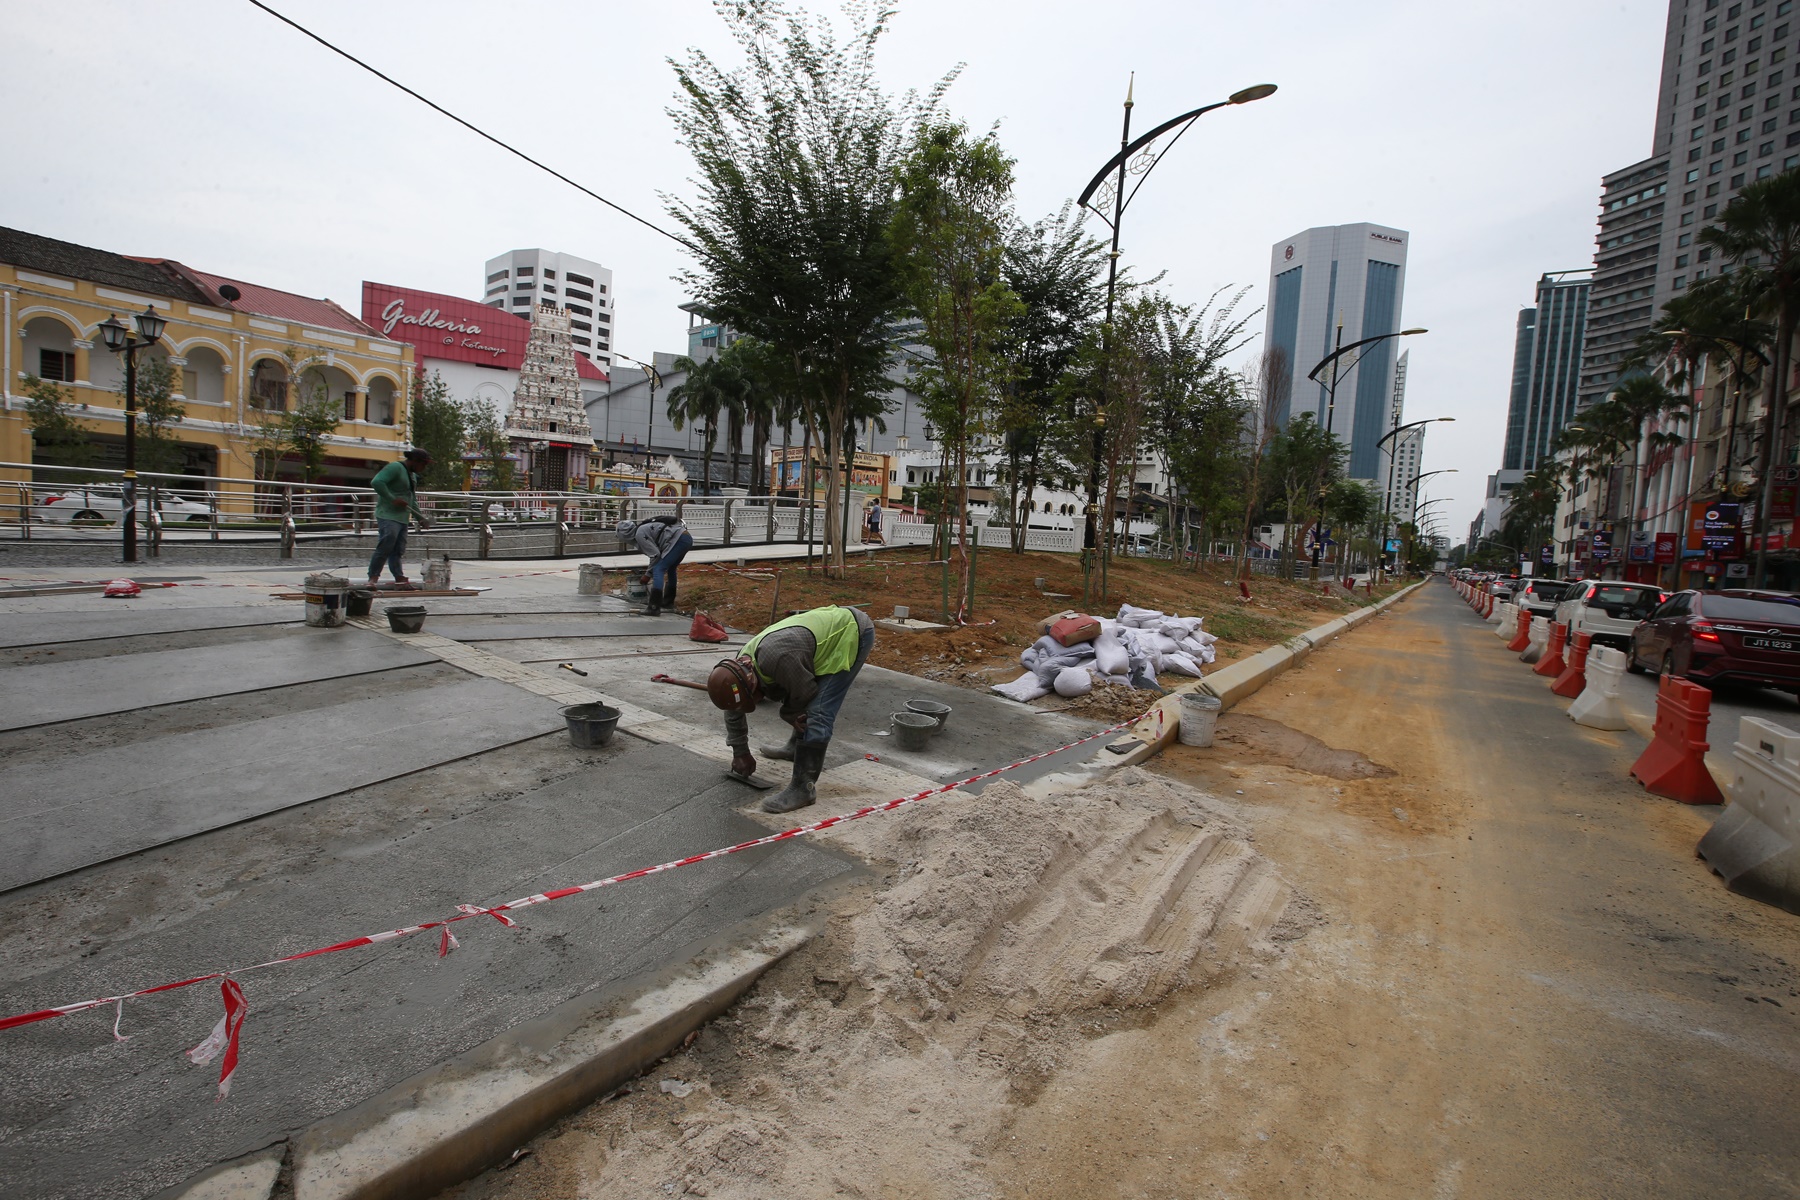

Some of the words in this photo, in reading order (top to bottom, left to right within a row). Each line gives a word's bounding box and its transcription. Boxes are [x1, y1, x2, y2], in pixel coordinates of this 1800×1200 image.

[381, 299, 482, 335] Galleria
[442, 336, 454, 345] @
[461, 338, 506, 357] Kotaraya
[1753, 639, 1770, 647] JTX
[1772, 641, 1792, 649] 1233
